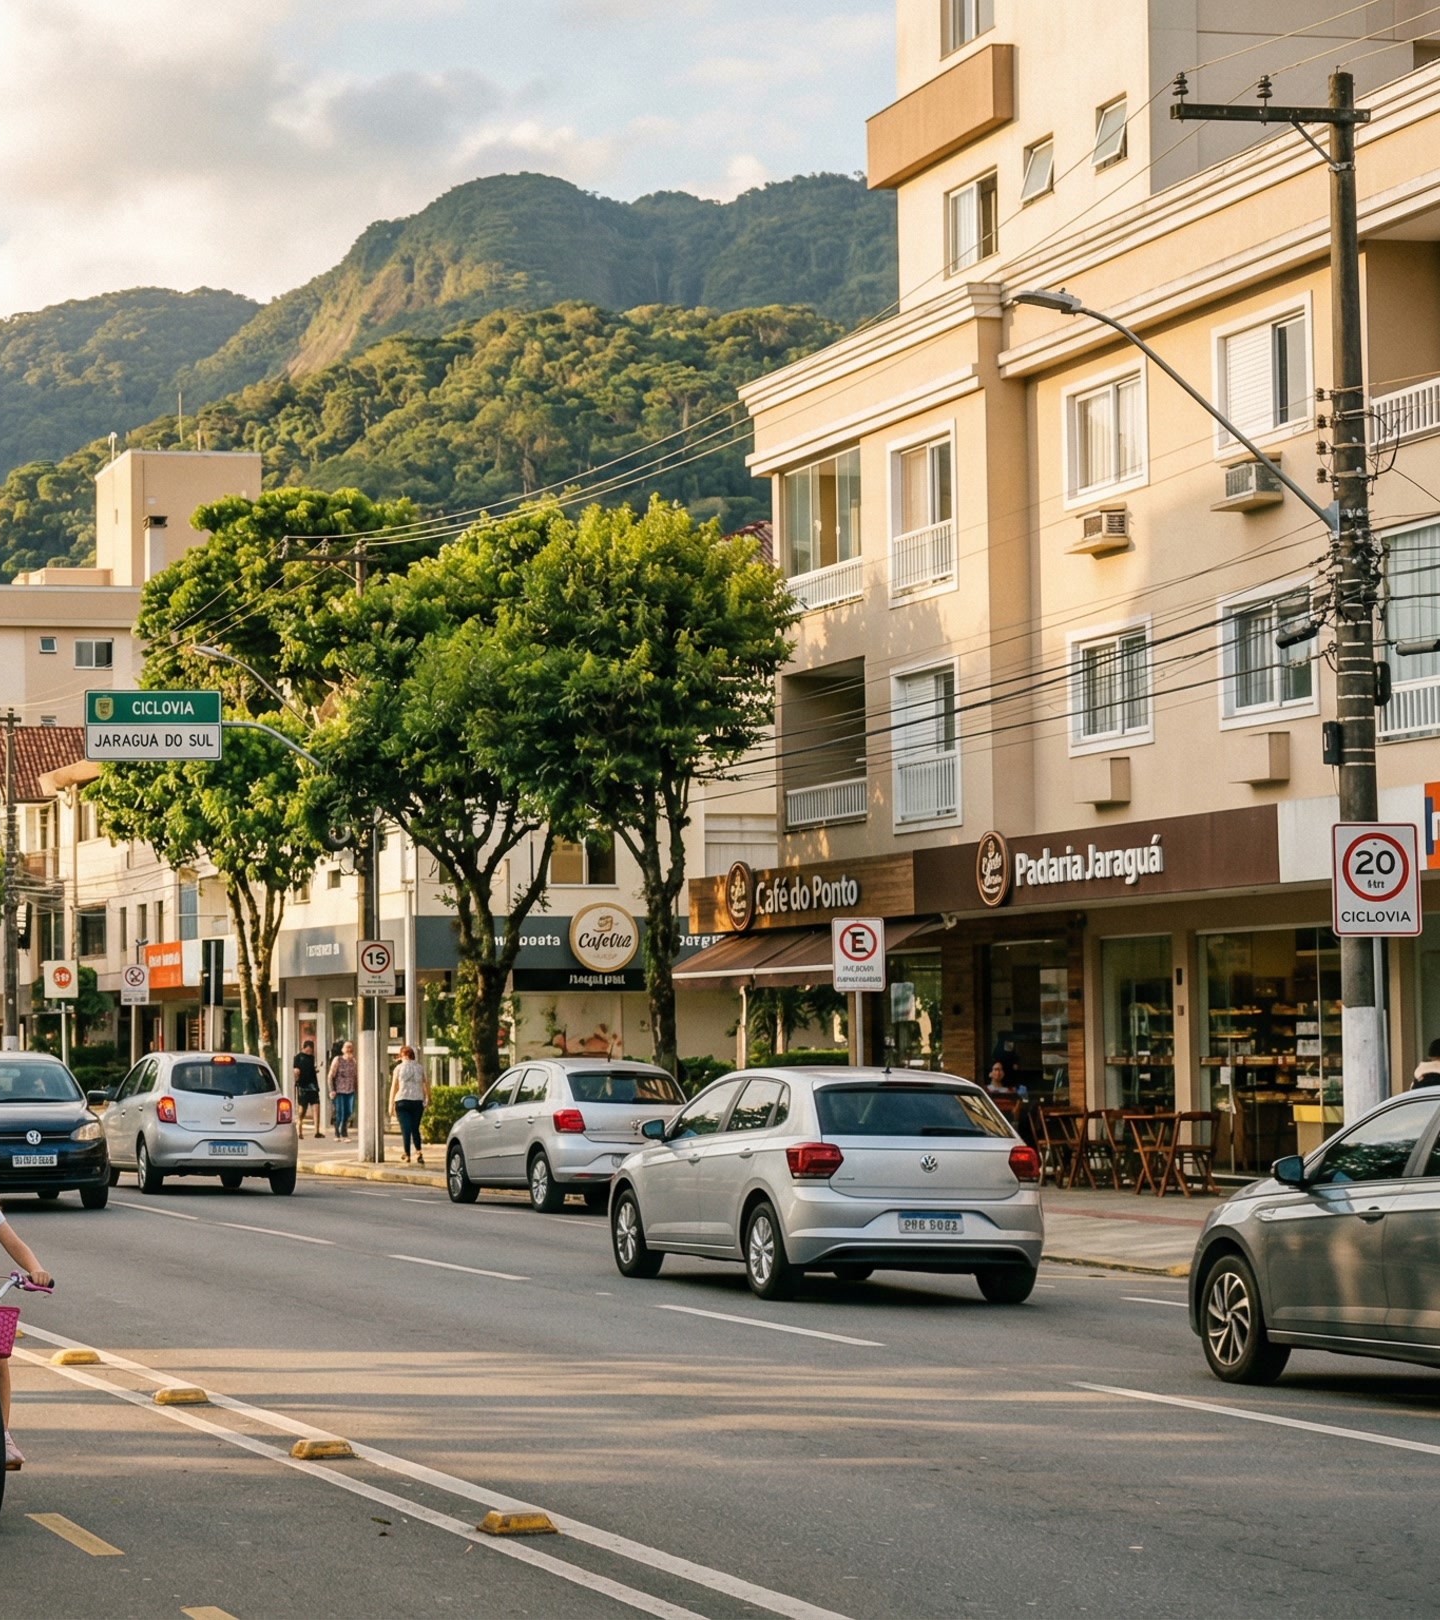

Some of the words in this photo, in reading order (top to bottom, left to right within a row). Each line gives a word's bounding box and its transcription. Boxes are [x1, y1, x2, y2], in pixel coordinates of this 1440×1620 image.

[131, 700, 195, 715] CICLOVIA
[94, 733, 159, 748] JARAGUA
[164, 733, 183, 747] DO
[188, 733, 214, 747] SUL
[1014, 845, 1086, 887] Padaria
[1084, 833, 1164, 886] Jaraguá
[1355, 850, 1396, 875] 20
[755, 876, 788, 915] Café
[790, 875, 810, 911] do
[812, 873, 858, 909] Ponto
[1341, 910, 1411, 923] CICLOVIA
[366, 951, 386, 966] 15
